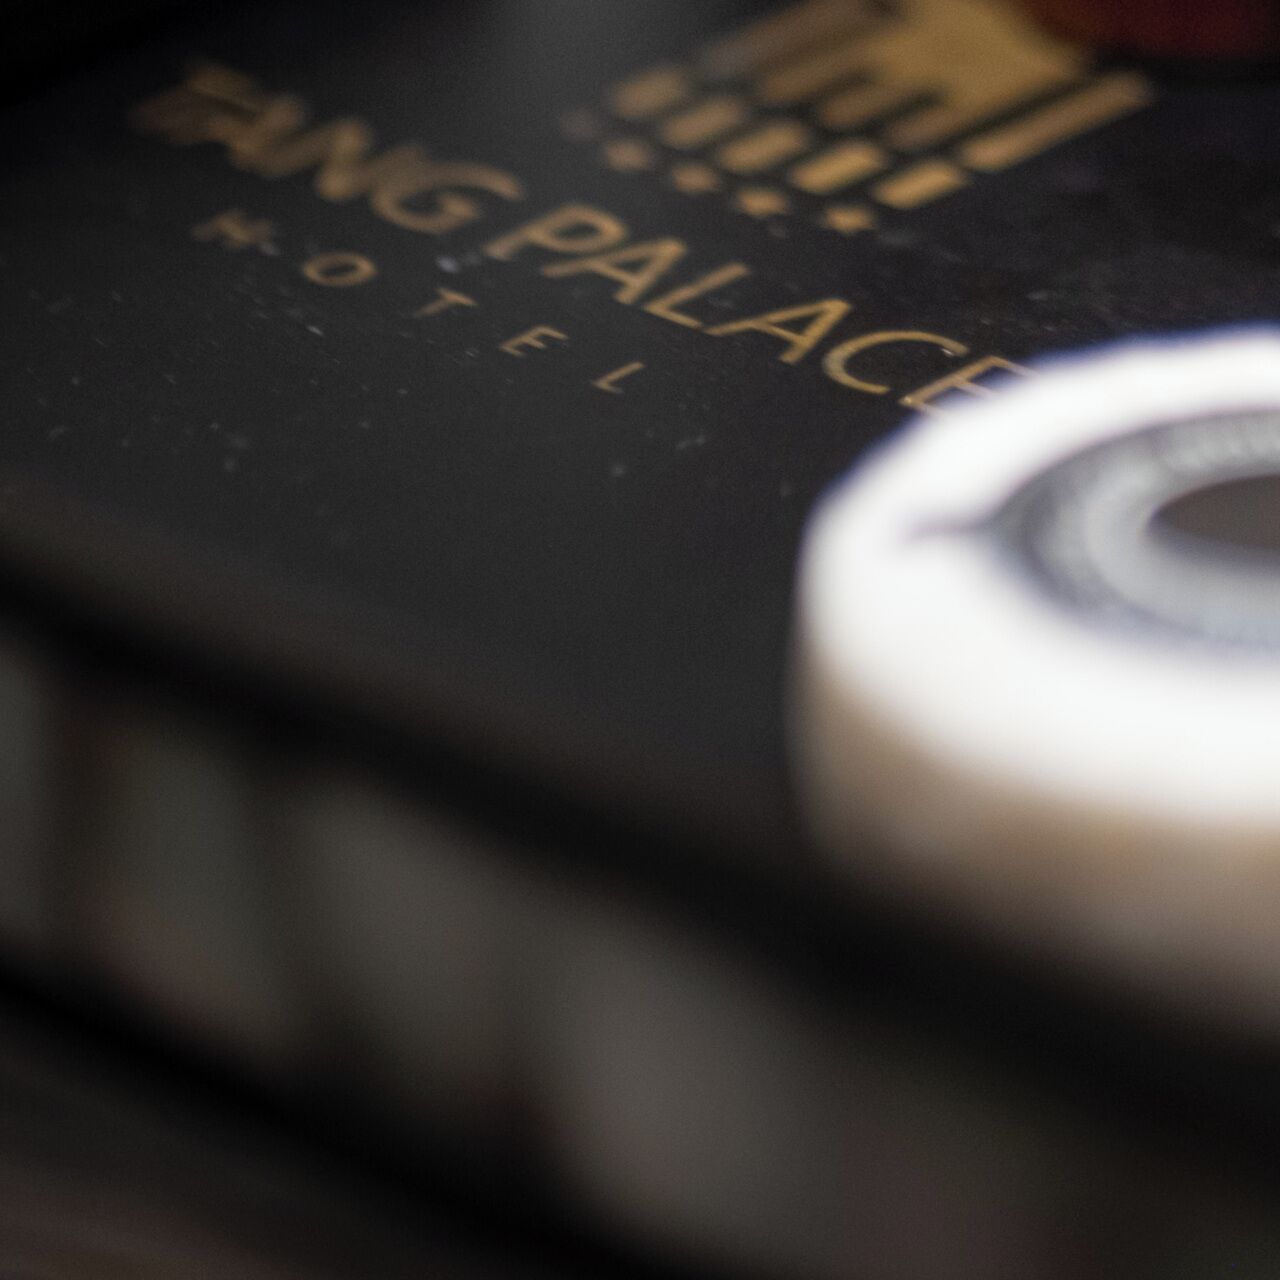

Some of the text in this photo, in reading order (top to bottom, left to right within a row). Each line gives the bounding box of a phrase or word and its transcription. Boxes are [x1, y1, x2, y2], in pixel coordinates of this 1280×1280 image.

[130, 60, 1040, 418] TANG PALACE
[192, 209, 646, 396] HOTEL
